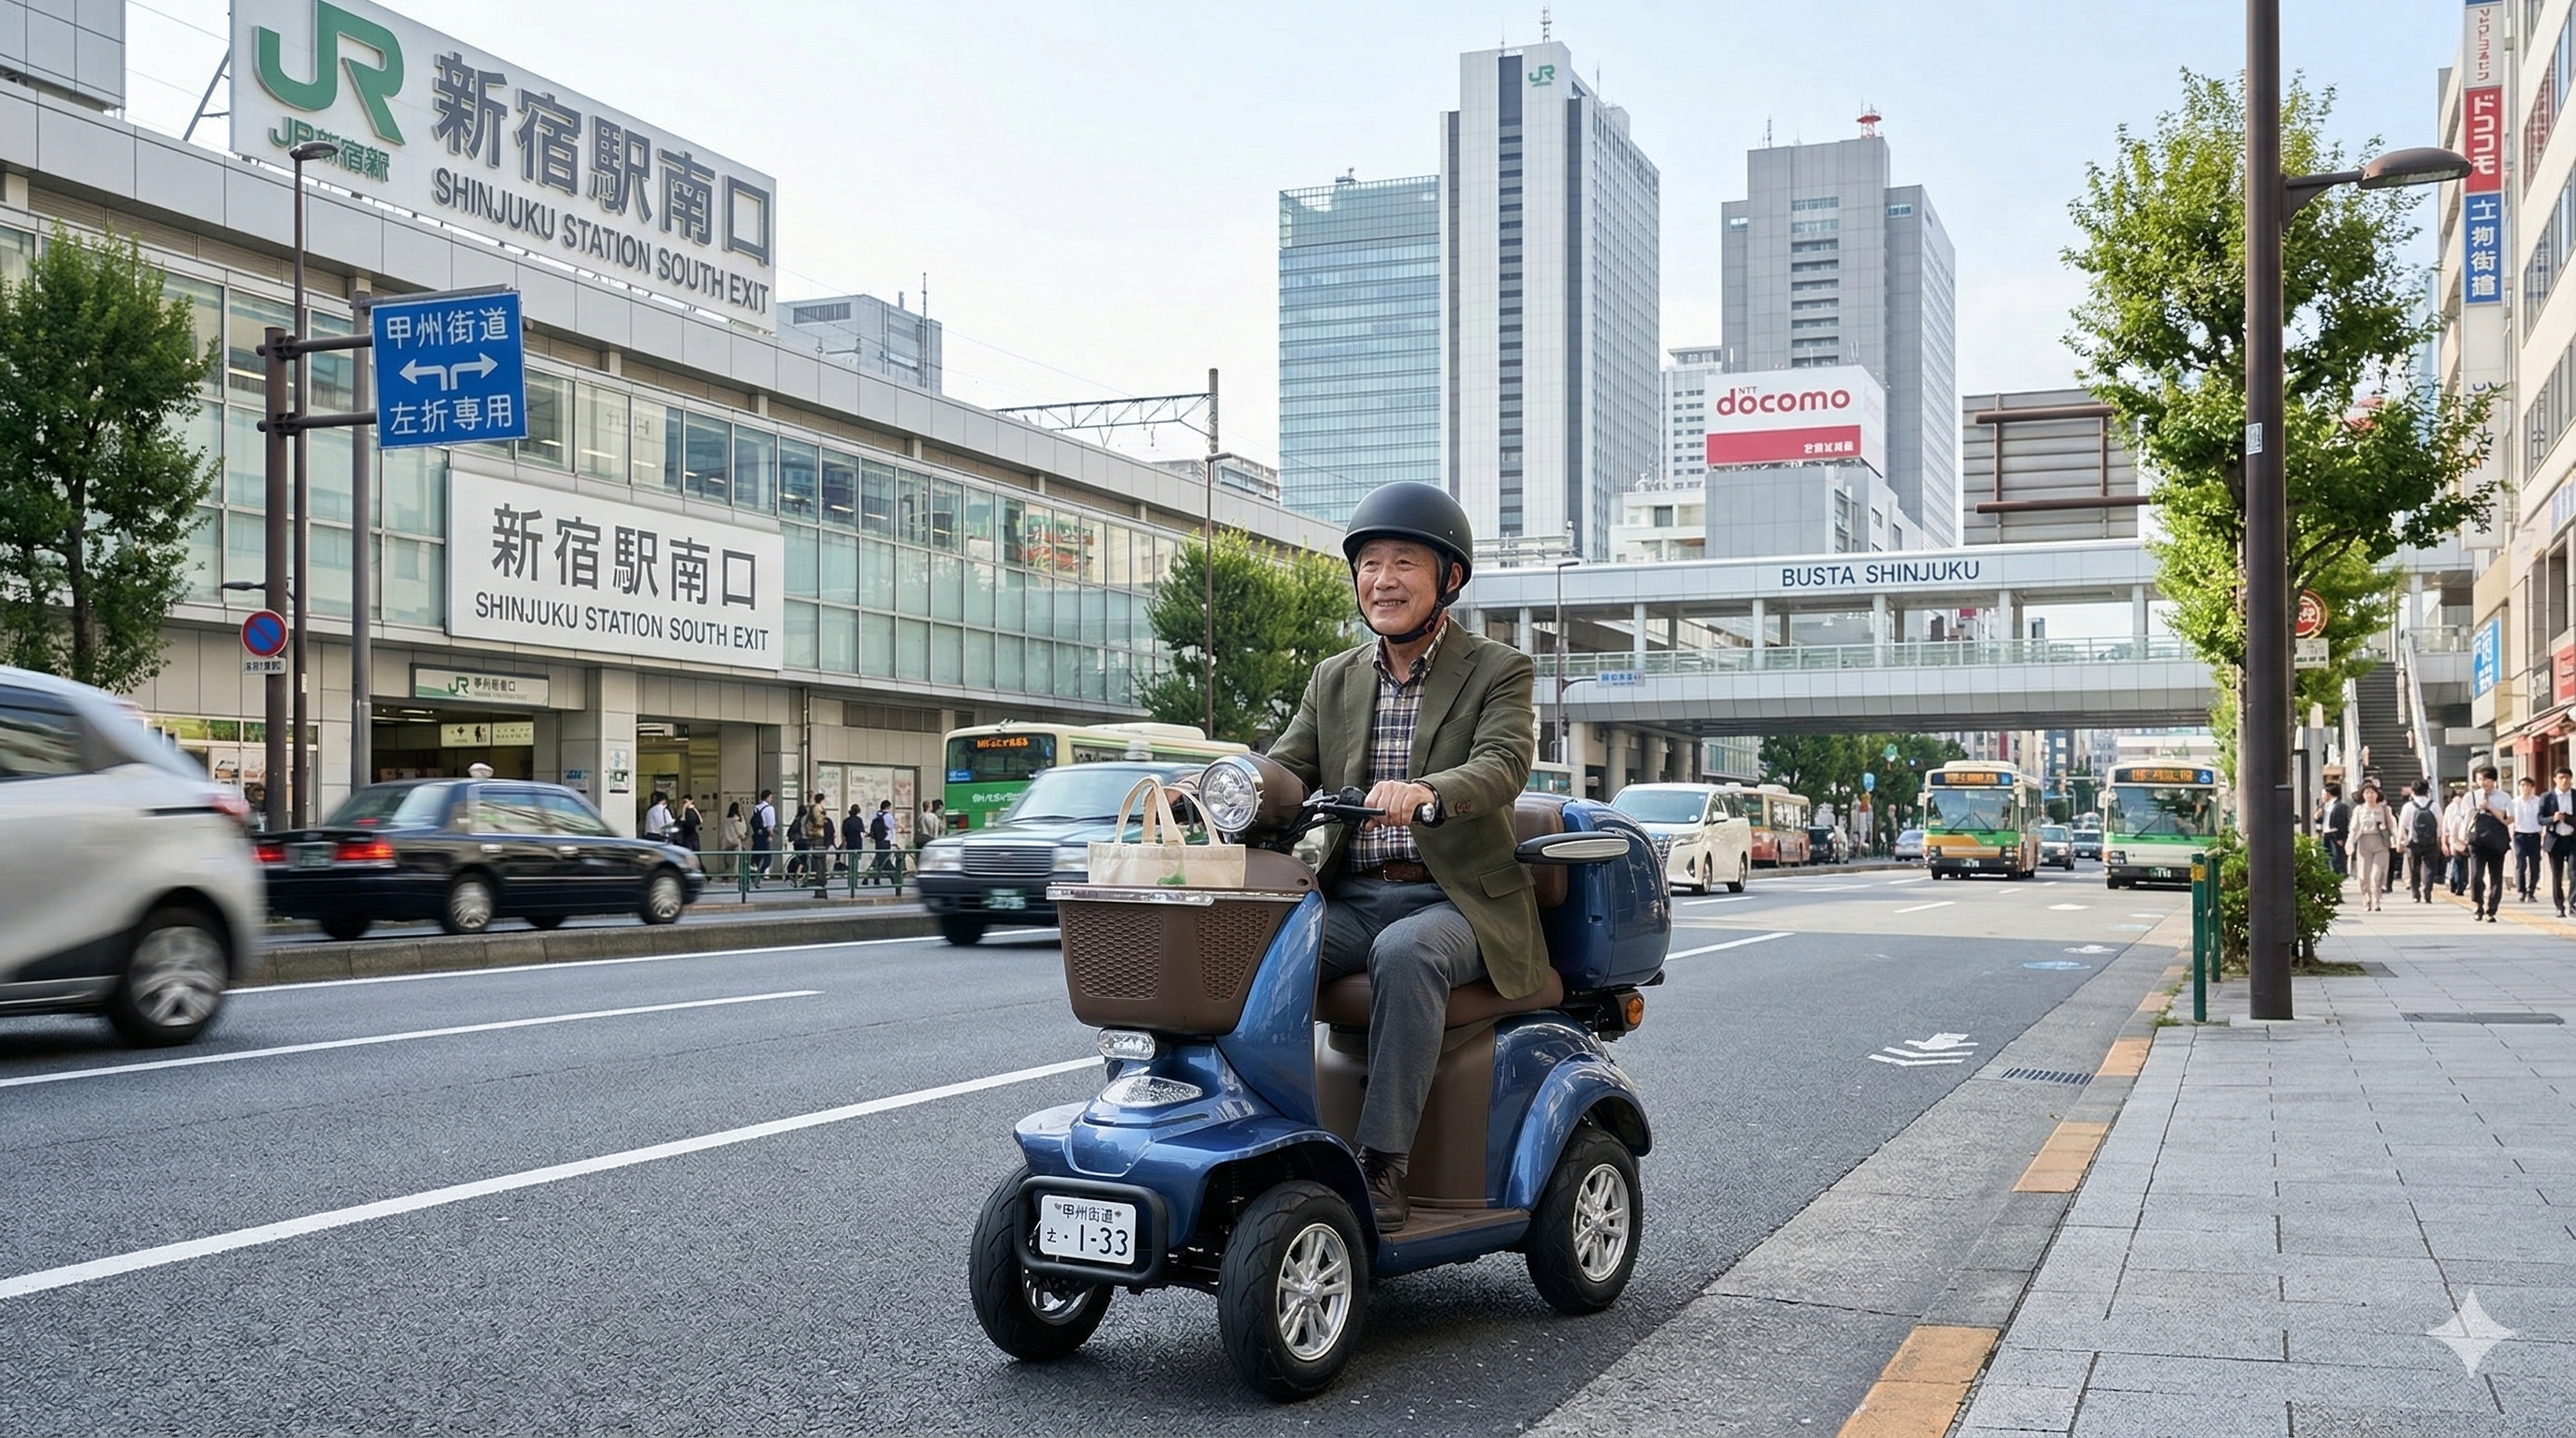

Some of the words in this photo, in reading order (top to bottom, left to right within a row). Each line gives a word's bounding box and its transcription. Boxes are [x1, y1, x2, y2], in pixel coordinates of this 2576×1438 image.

[254, 0, 405, 145] JR
[1529, 65, 1555, 82] JR
[433, 51, 771, 267] 新宿駅南口
[432, 168, 556, 241] SHINJUKU
[562, 213, 651, 274] STATION
[657, 247, 724, 301] SOUTH
[728, 273, 770, 315] EXIT
[387, 306, 509, 349] 甲州街道
[1717, 388, 1851, 416] docomo
[1738, 386, 1758, 395] NTT
[389, 394, 513, 436] 左折専用
[490, 503, 757, 610] 新宿駅南口
[1781, 566, 1855, 587] BUSTA
[1866, 561, 1980, 583] SHINJUKU
[475, 591, 578, 629] SHINJUKU
[585, 610, 664, 638] STATION
[669, 618, 728, 648] SOUTH
[733, 625, 769, 652] EXIT
[448, 676, 469, 694] JR
